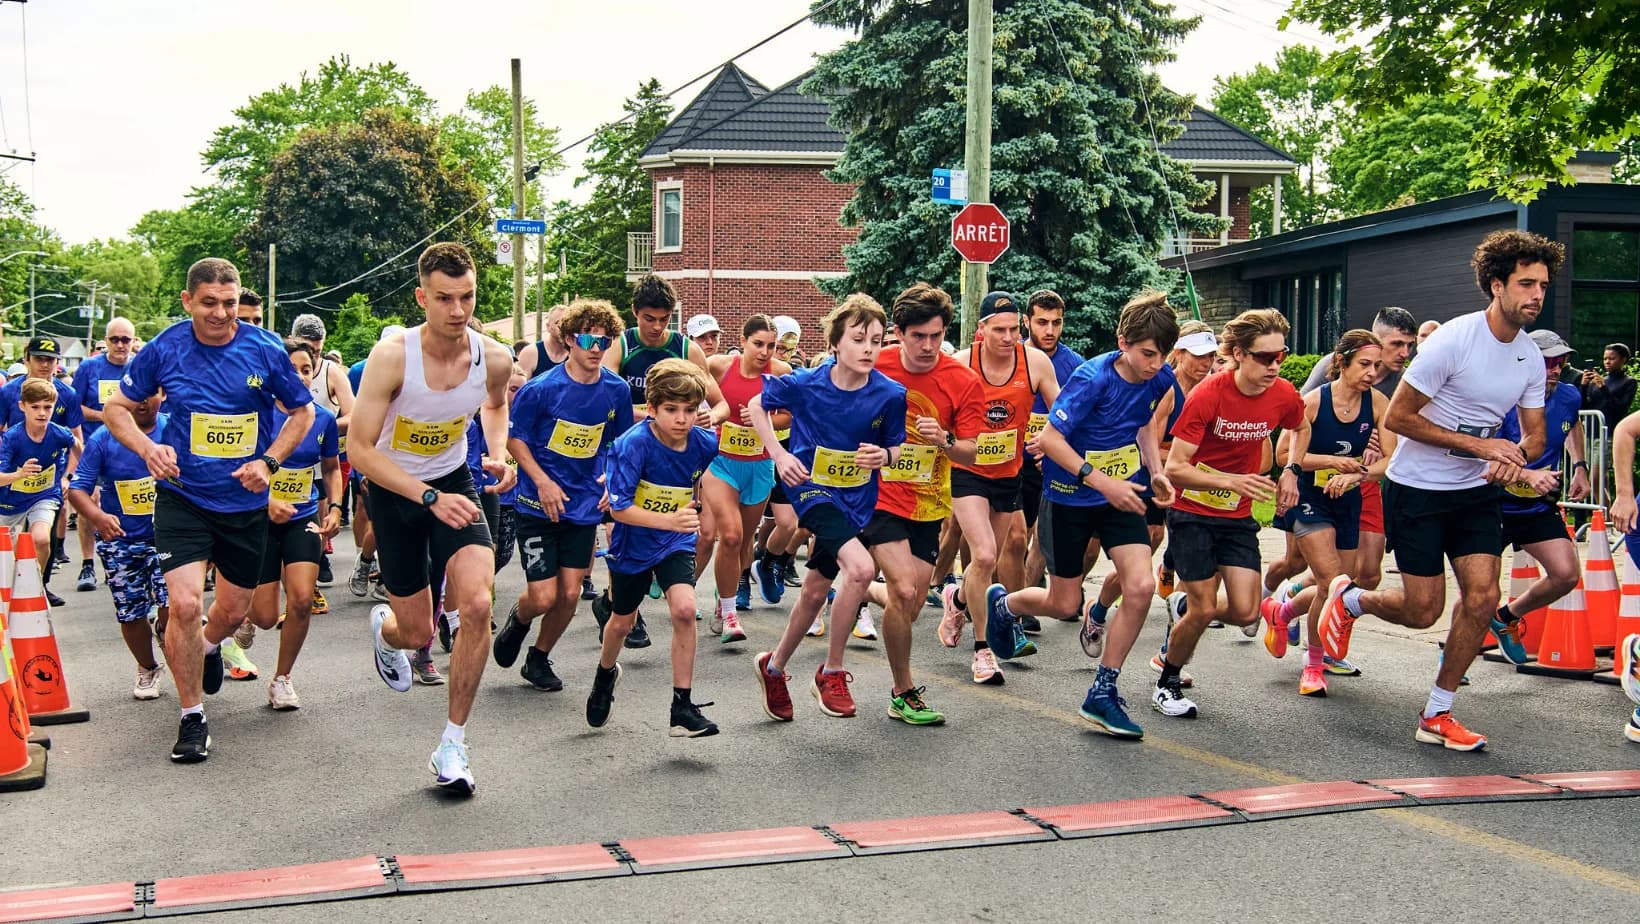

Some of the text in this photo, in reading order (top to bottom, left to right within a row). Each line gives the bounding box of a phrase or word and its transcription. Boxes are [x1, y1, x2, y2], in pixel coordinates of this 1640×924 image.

[933, 177, 945, 186] 20
[501, 224, 541, 232] Clermont
[955, 222, 1007, 243] ARRÊT
[626, 375, 647, 388] KO
[1220, 419, 1268, 430] Fondeurs
[206, 431, 244, 445] 6057
[409, 433, 449, 446] 5083
[563, 436, 593, 449] 5537
[729, 435, 755, 447] 6193
[977, 444, 1006, 455] 6602
[828, 464, 860, 477] 6127
[272, 480, 303, 493] 5262
[642, 498, 679, 513] 5284
